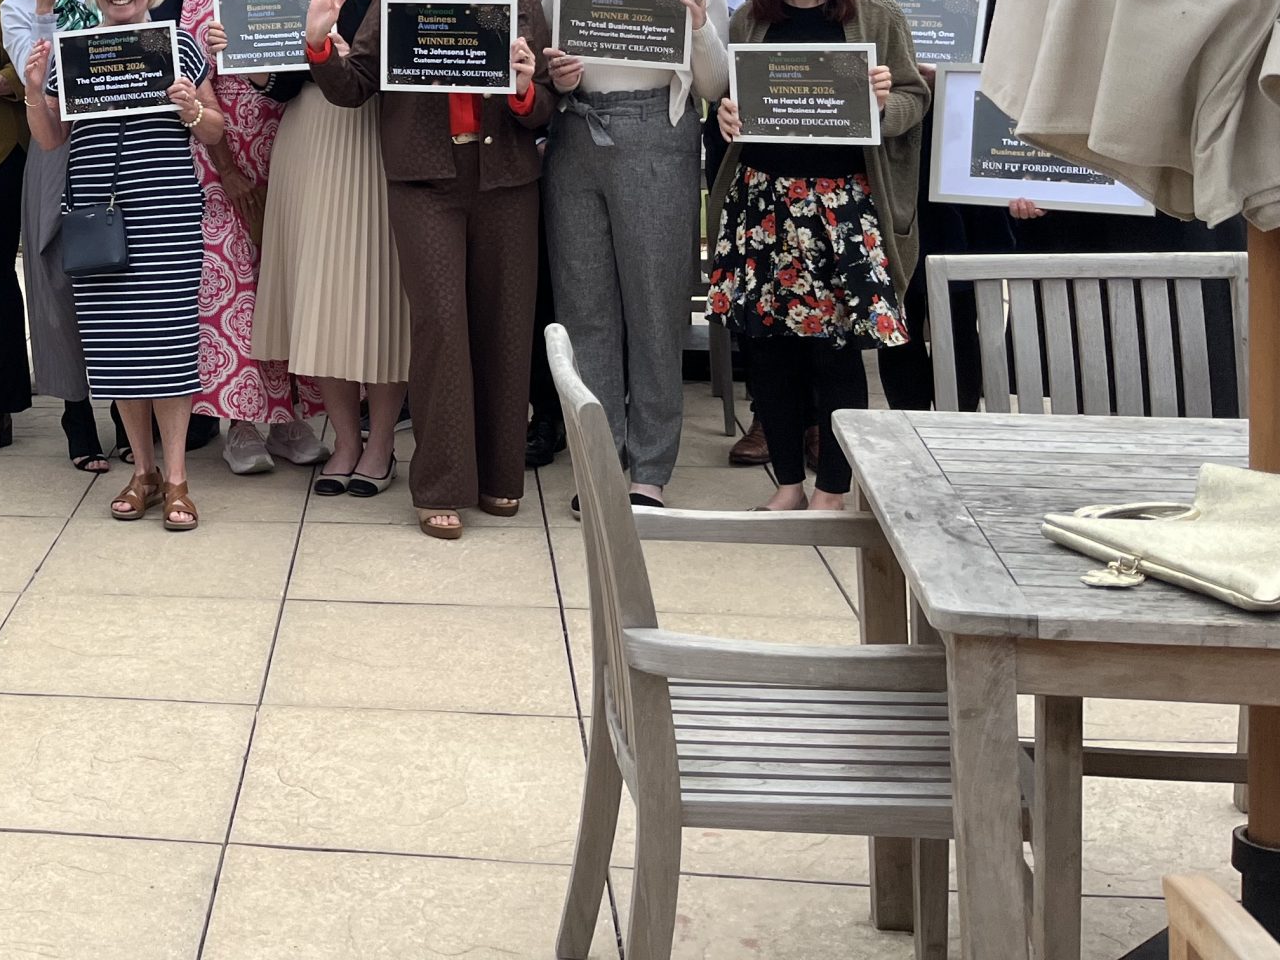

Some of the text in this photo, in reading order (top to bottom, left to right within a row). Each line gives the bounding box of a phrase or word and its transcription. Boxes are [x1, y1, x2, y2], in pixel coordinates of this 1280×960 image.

[592, 11, 652, 22] WINNER 2026
[418, 37, 478, 46] WINNER 2026
[88, 45, 122, 54] Business
[568, 40, 674, 54] EMMA'S SWEET CREATIONS
[90, 52, 116, 60] Awards
[227, 52, 262, 60] VERWOOD
[413, 48, 428, 56] The
[429, 48, 464, 56] Johnsons
[90, 62, 144, 74] WINNER 2026
[106, 73, 139, 82] Executive
[140, 70, 162, 79] Travel
[462, 70, 503, 78] SOLUTIONS
[770, 86, 834, 94] WINNER 2026
[75, 90, 166, 105] PADUA COMMUNICATIONS
[780, 97, 806, 105] Harold
[758, 118, 850, 126] HABGOOD EDUCATION
[991, 148, 1024, 156] Business
[982, 161, 1002, 170] RUN
[1022, 164, 1103, 176] FORDINGBRID
